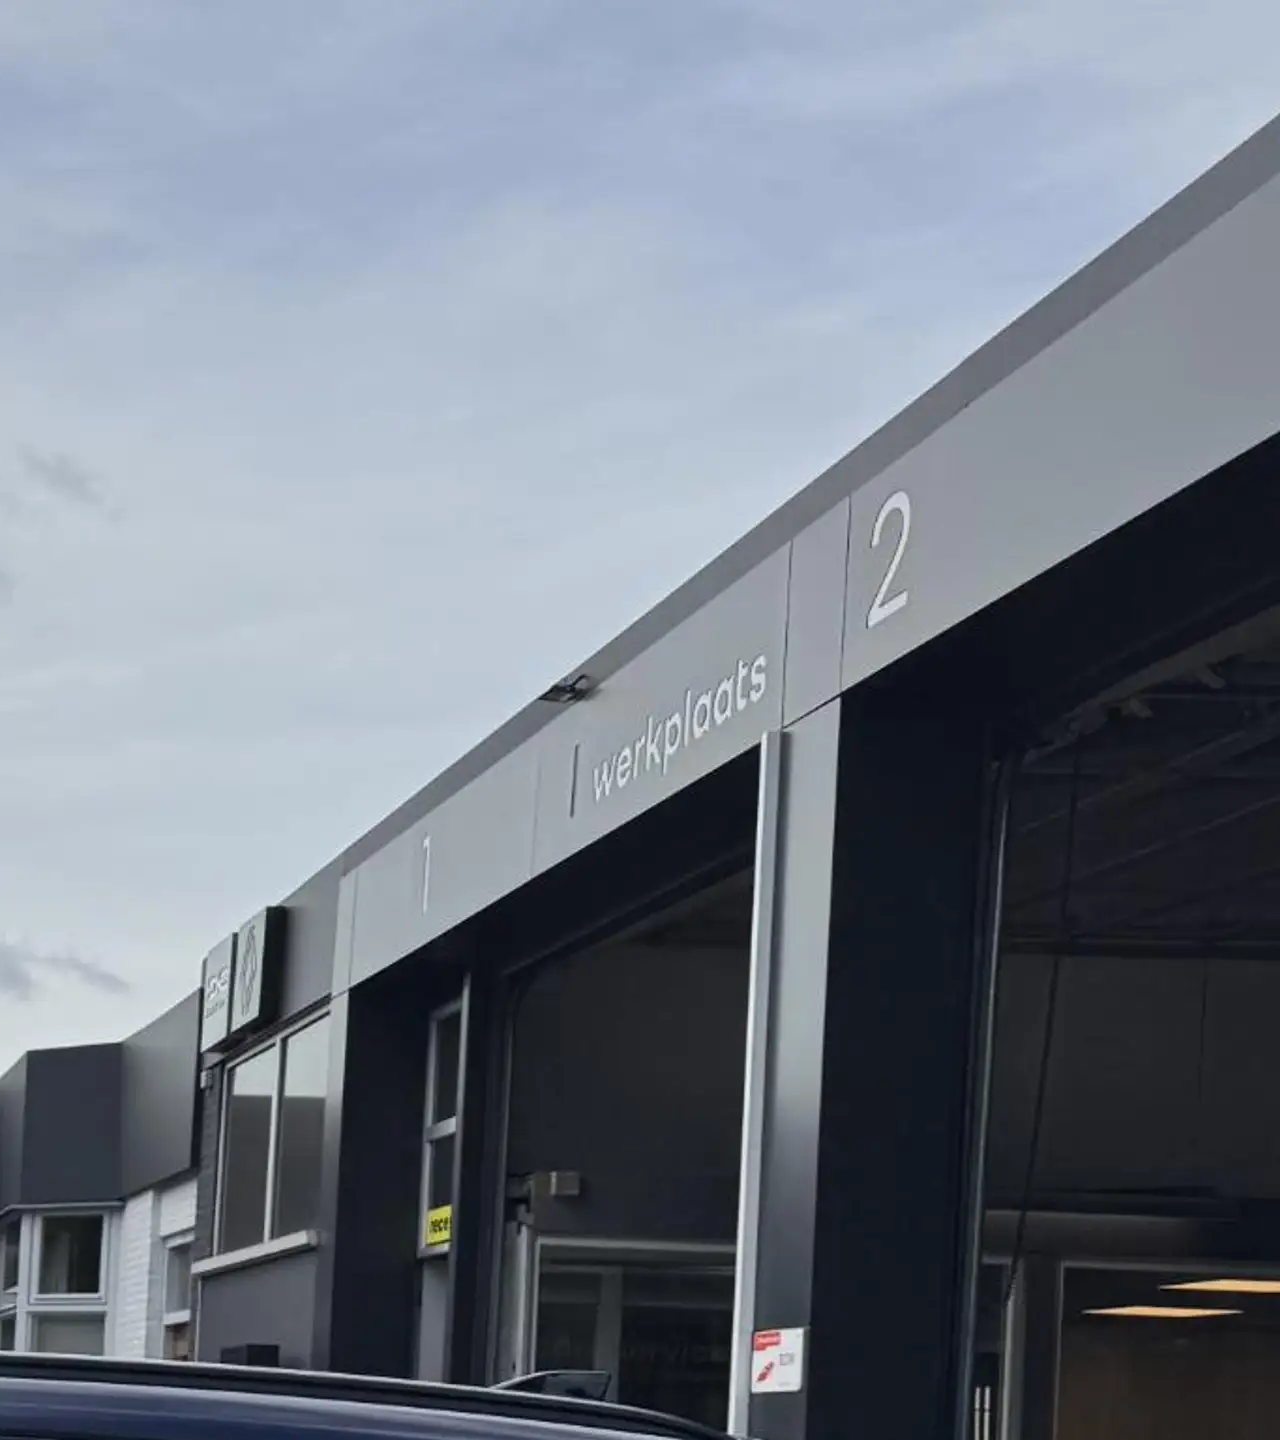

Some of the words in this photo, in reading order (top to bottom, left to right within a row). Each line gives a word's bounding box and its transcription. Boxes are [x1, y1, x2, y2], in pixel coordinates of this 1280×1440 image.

[867, 491, 911, 629] 2
[593, 654, 767, 802] werkplaats
[422, 834, 432, 915] 1
